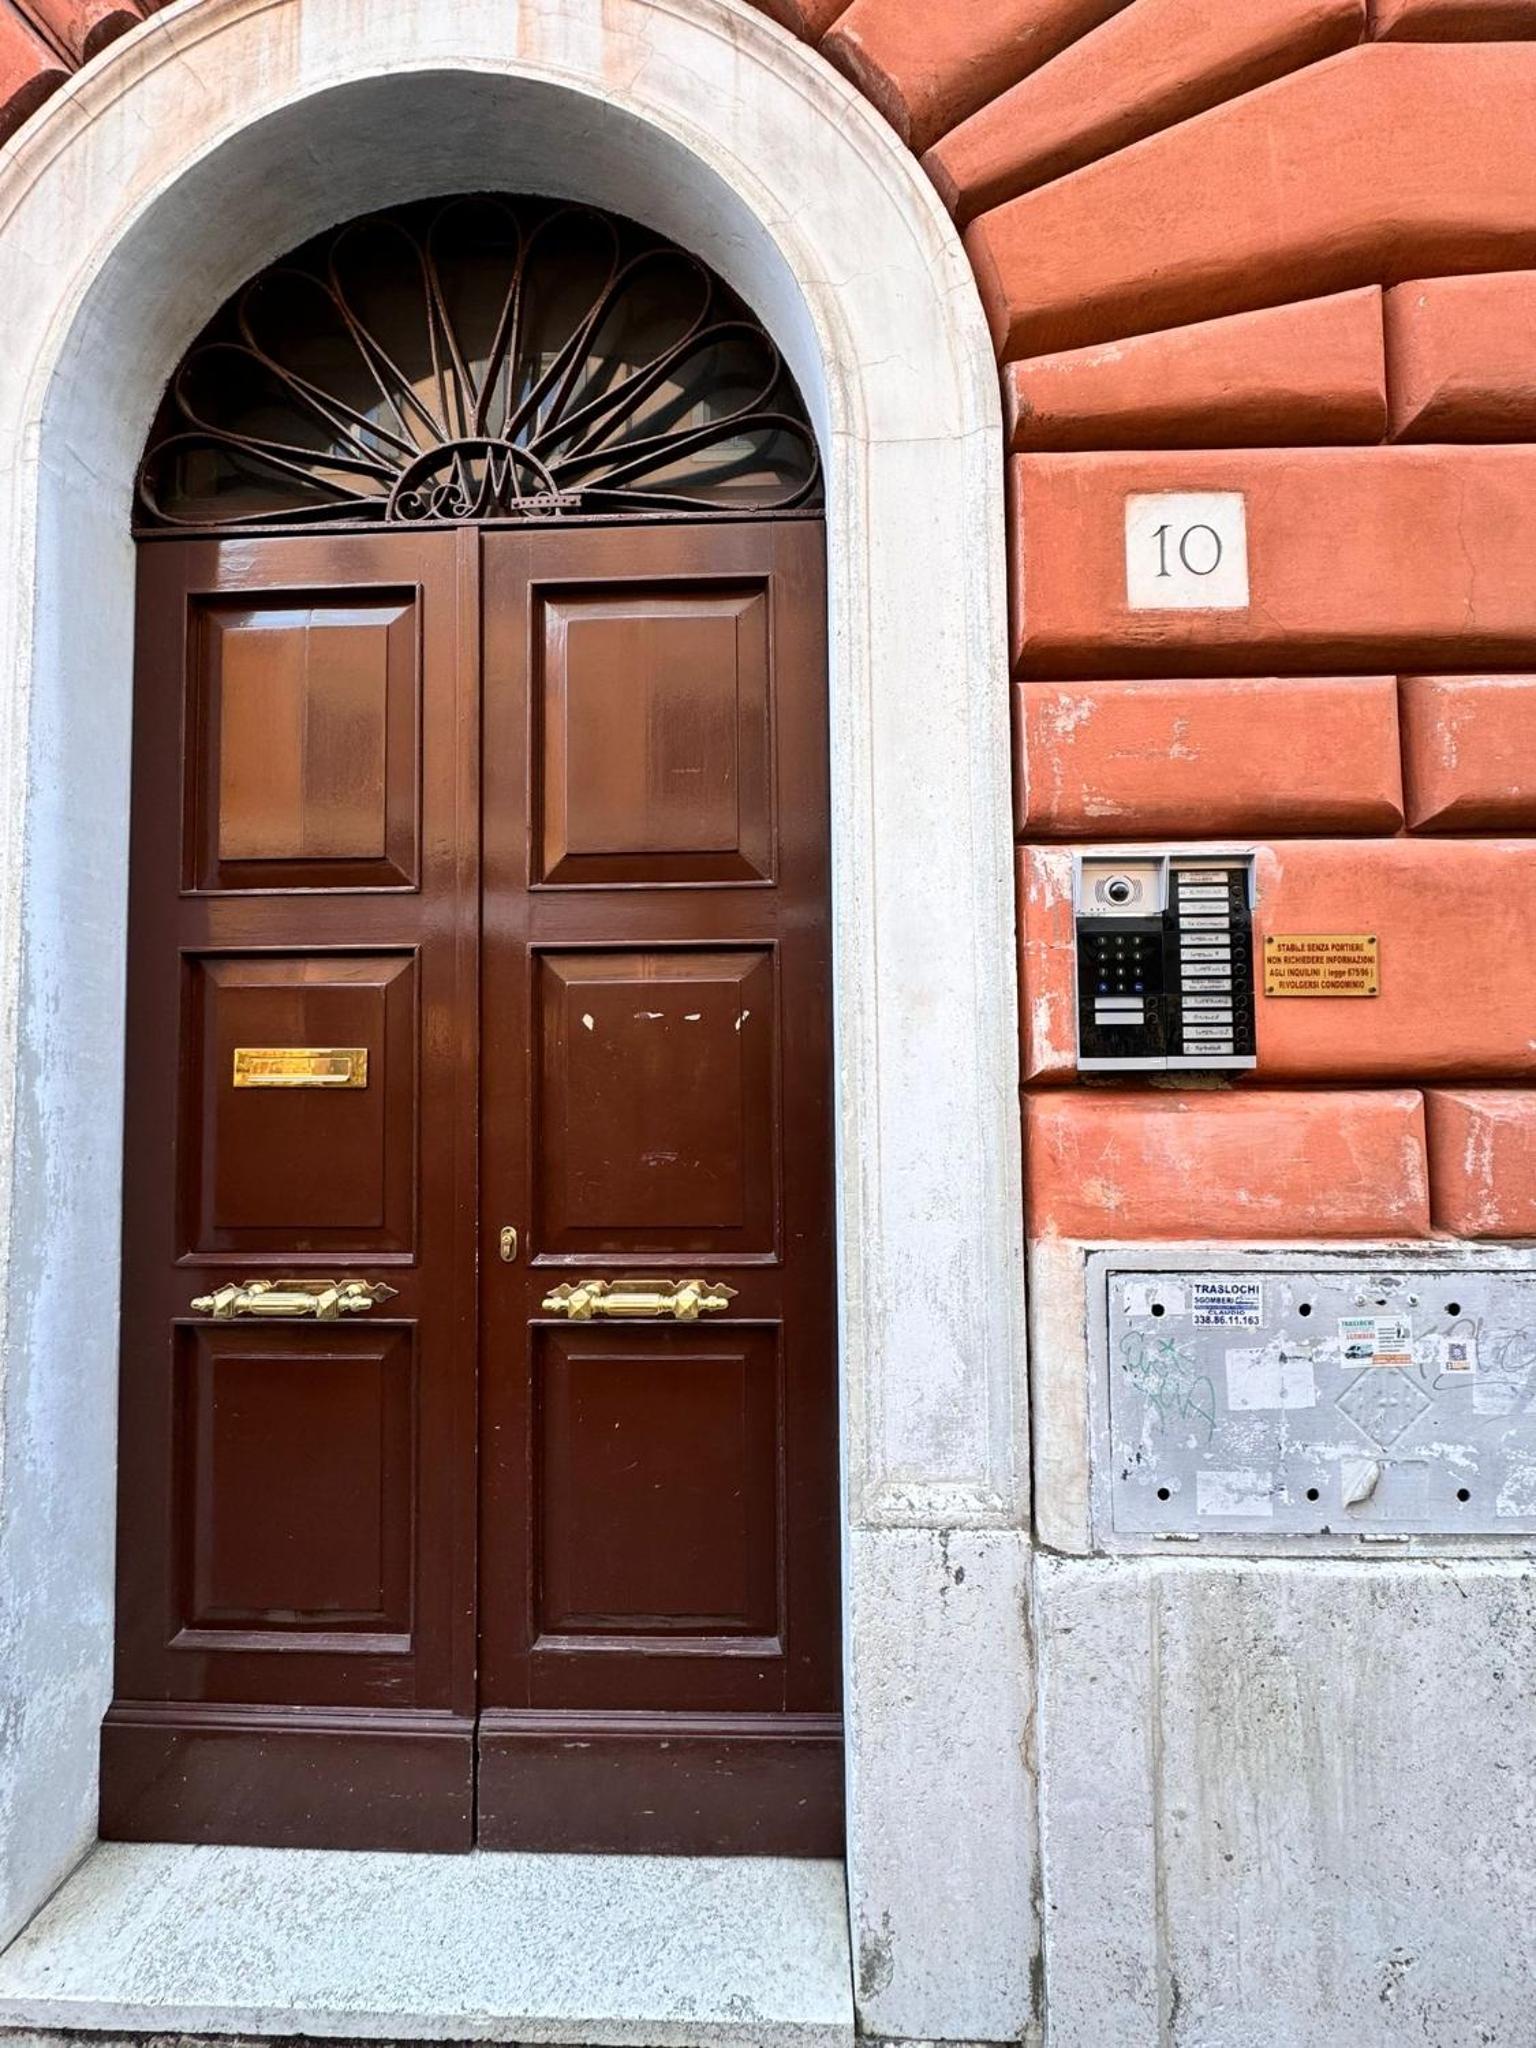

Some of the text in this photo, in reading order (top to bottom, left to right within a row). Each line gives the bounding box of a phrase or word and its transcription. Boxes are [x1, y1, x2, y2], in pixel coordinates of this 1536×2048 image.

[1151, 523, 1223, 577] 10
[1277, 943, 1364, 952] STABILE SENZA PORTIERE
[1267, 956, 1375, 965] NON RICHIEDERE INFORMAZIONI
[1269, 968, 1285, 977] AGLI
[1287, 968, 1320, 977] INQUILINI
[1279, 981, 1365, 989] RIVOLGERSI CONDOMINIO
[1194, 1284, 1259, 1294] TRASLOCHI
[1194, 1315, 1259, 1325] 338.86.11.163
